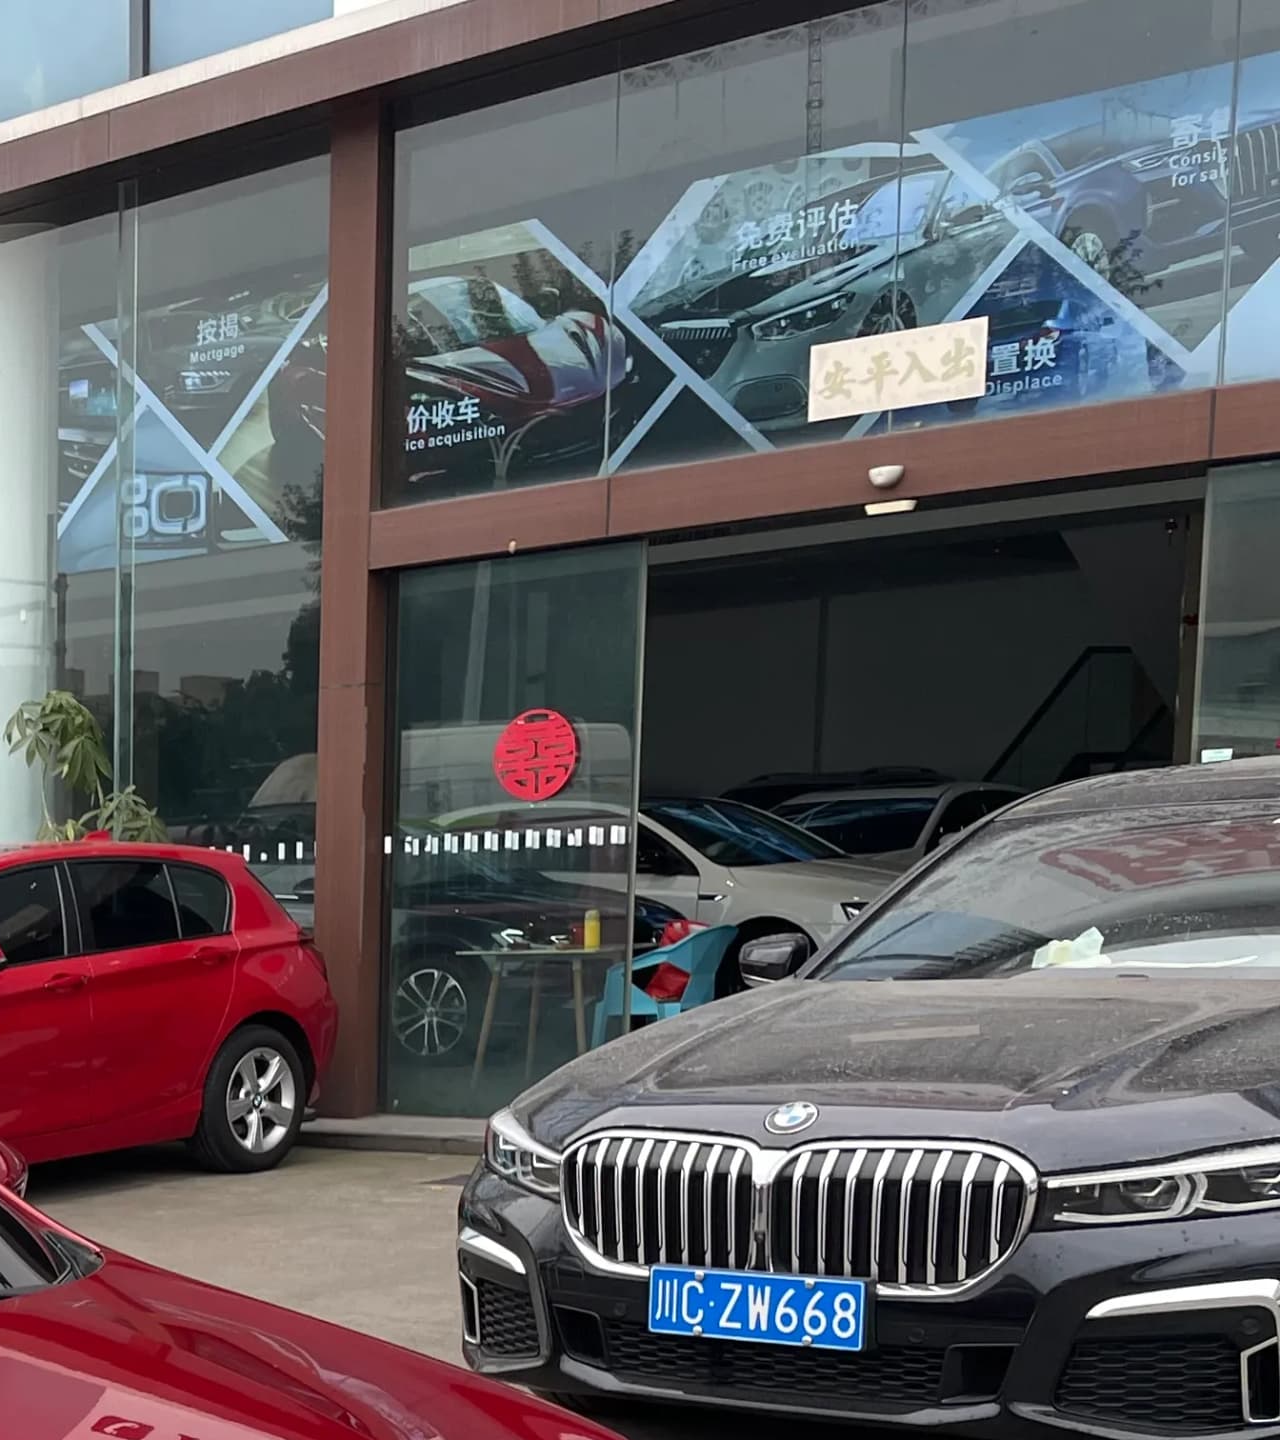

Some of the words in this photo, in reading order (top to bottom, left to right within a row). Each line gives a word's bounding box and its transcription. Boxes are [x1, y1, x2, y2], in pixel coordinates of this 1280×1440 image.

[733, 198, 859, 252] 免费评估
[732, 254, 768, 273] Free
[196, 312, 239, 347] 按揭
[189, 344, 246, 364] Mortgage
[990, 338, 1057, 377] 置换
[427, 424, 506, 448] acquisition
[655, 1279, 857, 1338] 川C·ZW668
